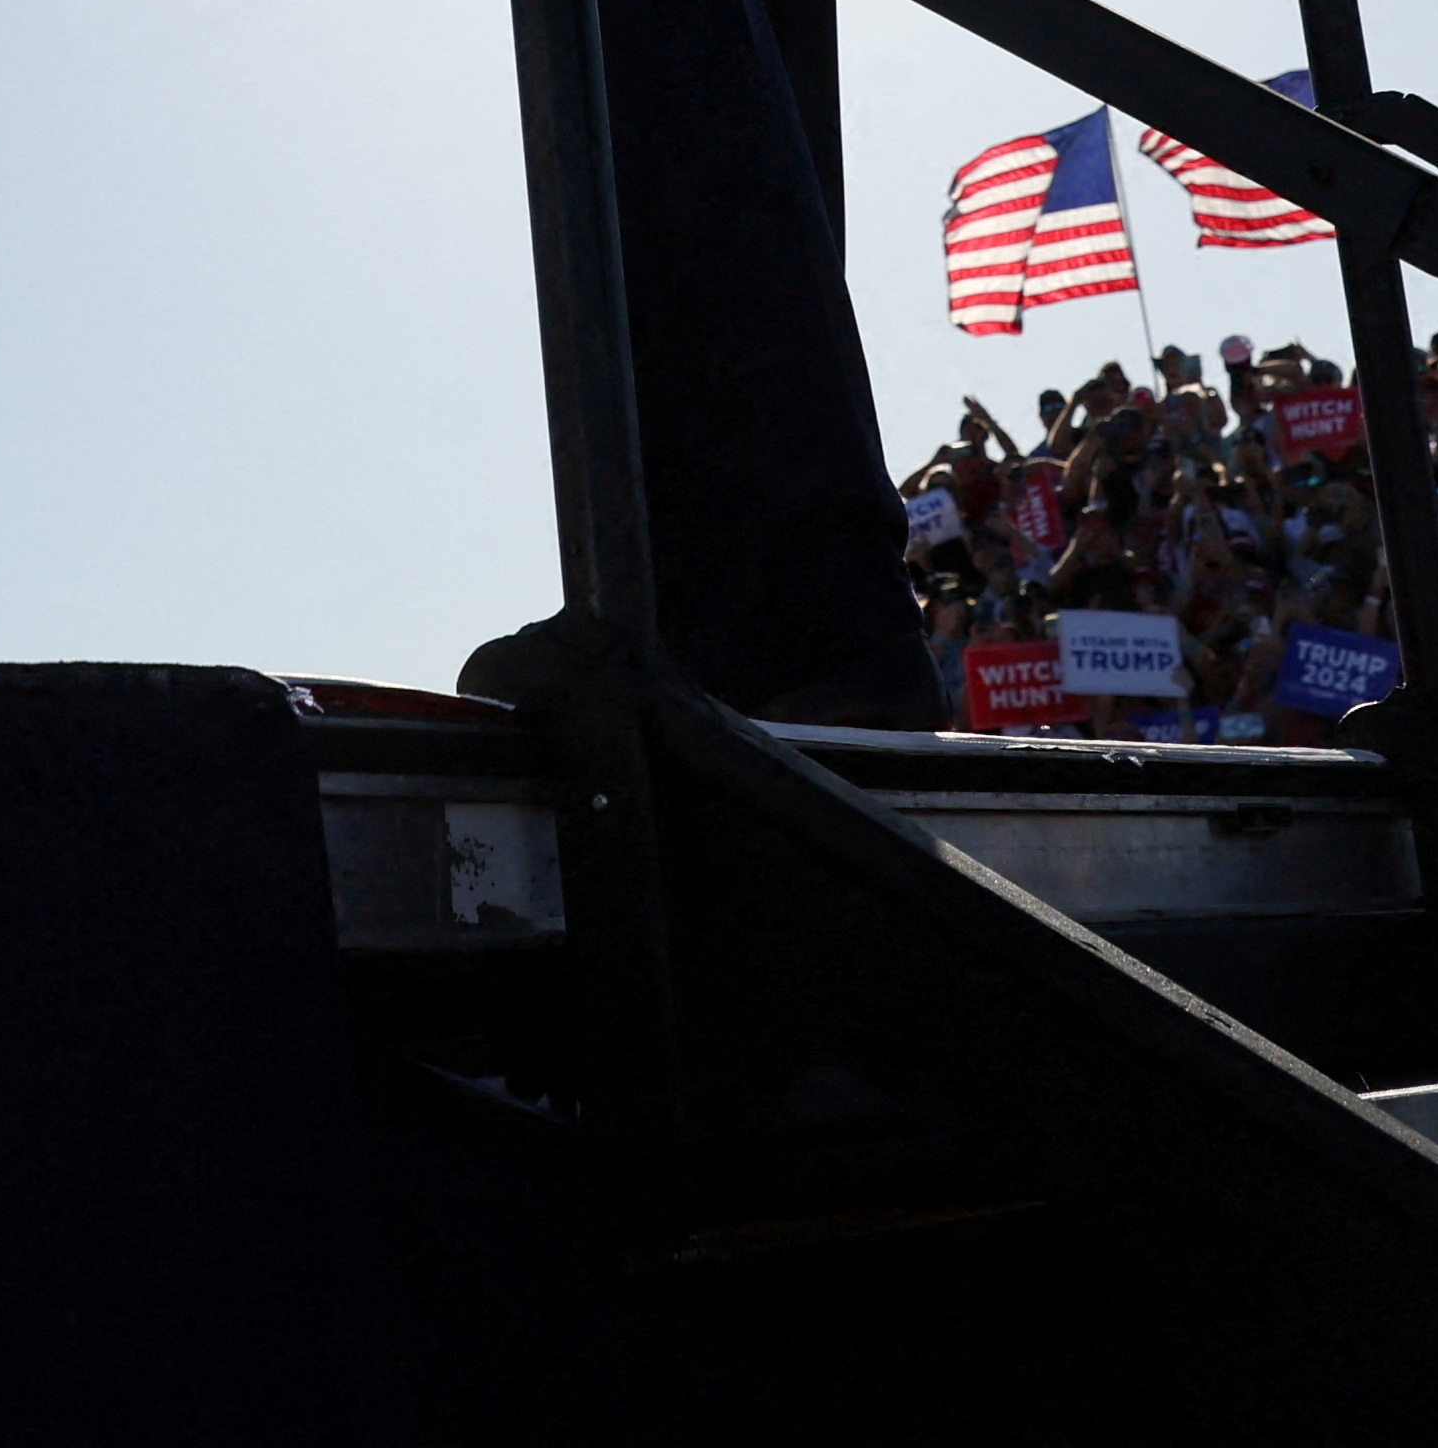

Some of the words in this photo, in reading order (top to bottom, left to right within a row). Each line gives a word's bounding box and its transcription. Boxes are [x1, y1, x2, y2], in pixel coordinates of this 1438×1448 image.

[1282, 399, 1355, 422] WITCH
[1290, 416, 1348, 441] HUNT
[1071, 650, 1175, 672] TRUMP
[1295, 639, 1389, 674] TRUMP
[1300, 663, 1368, 694] 2024
